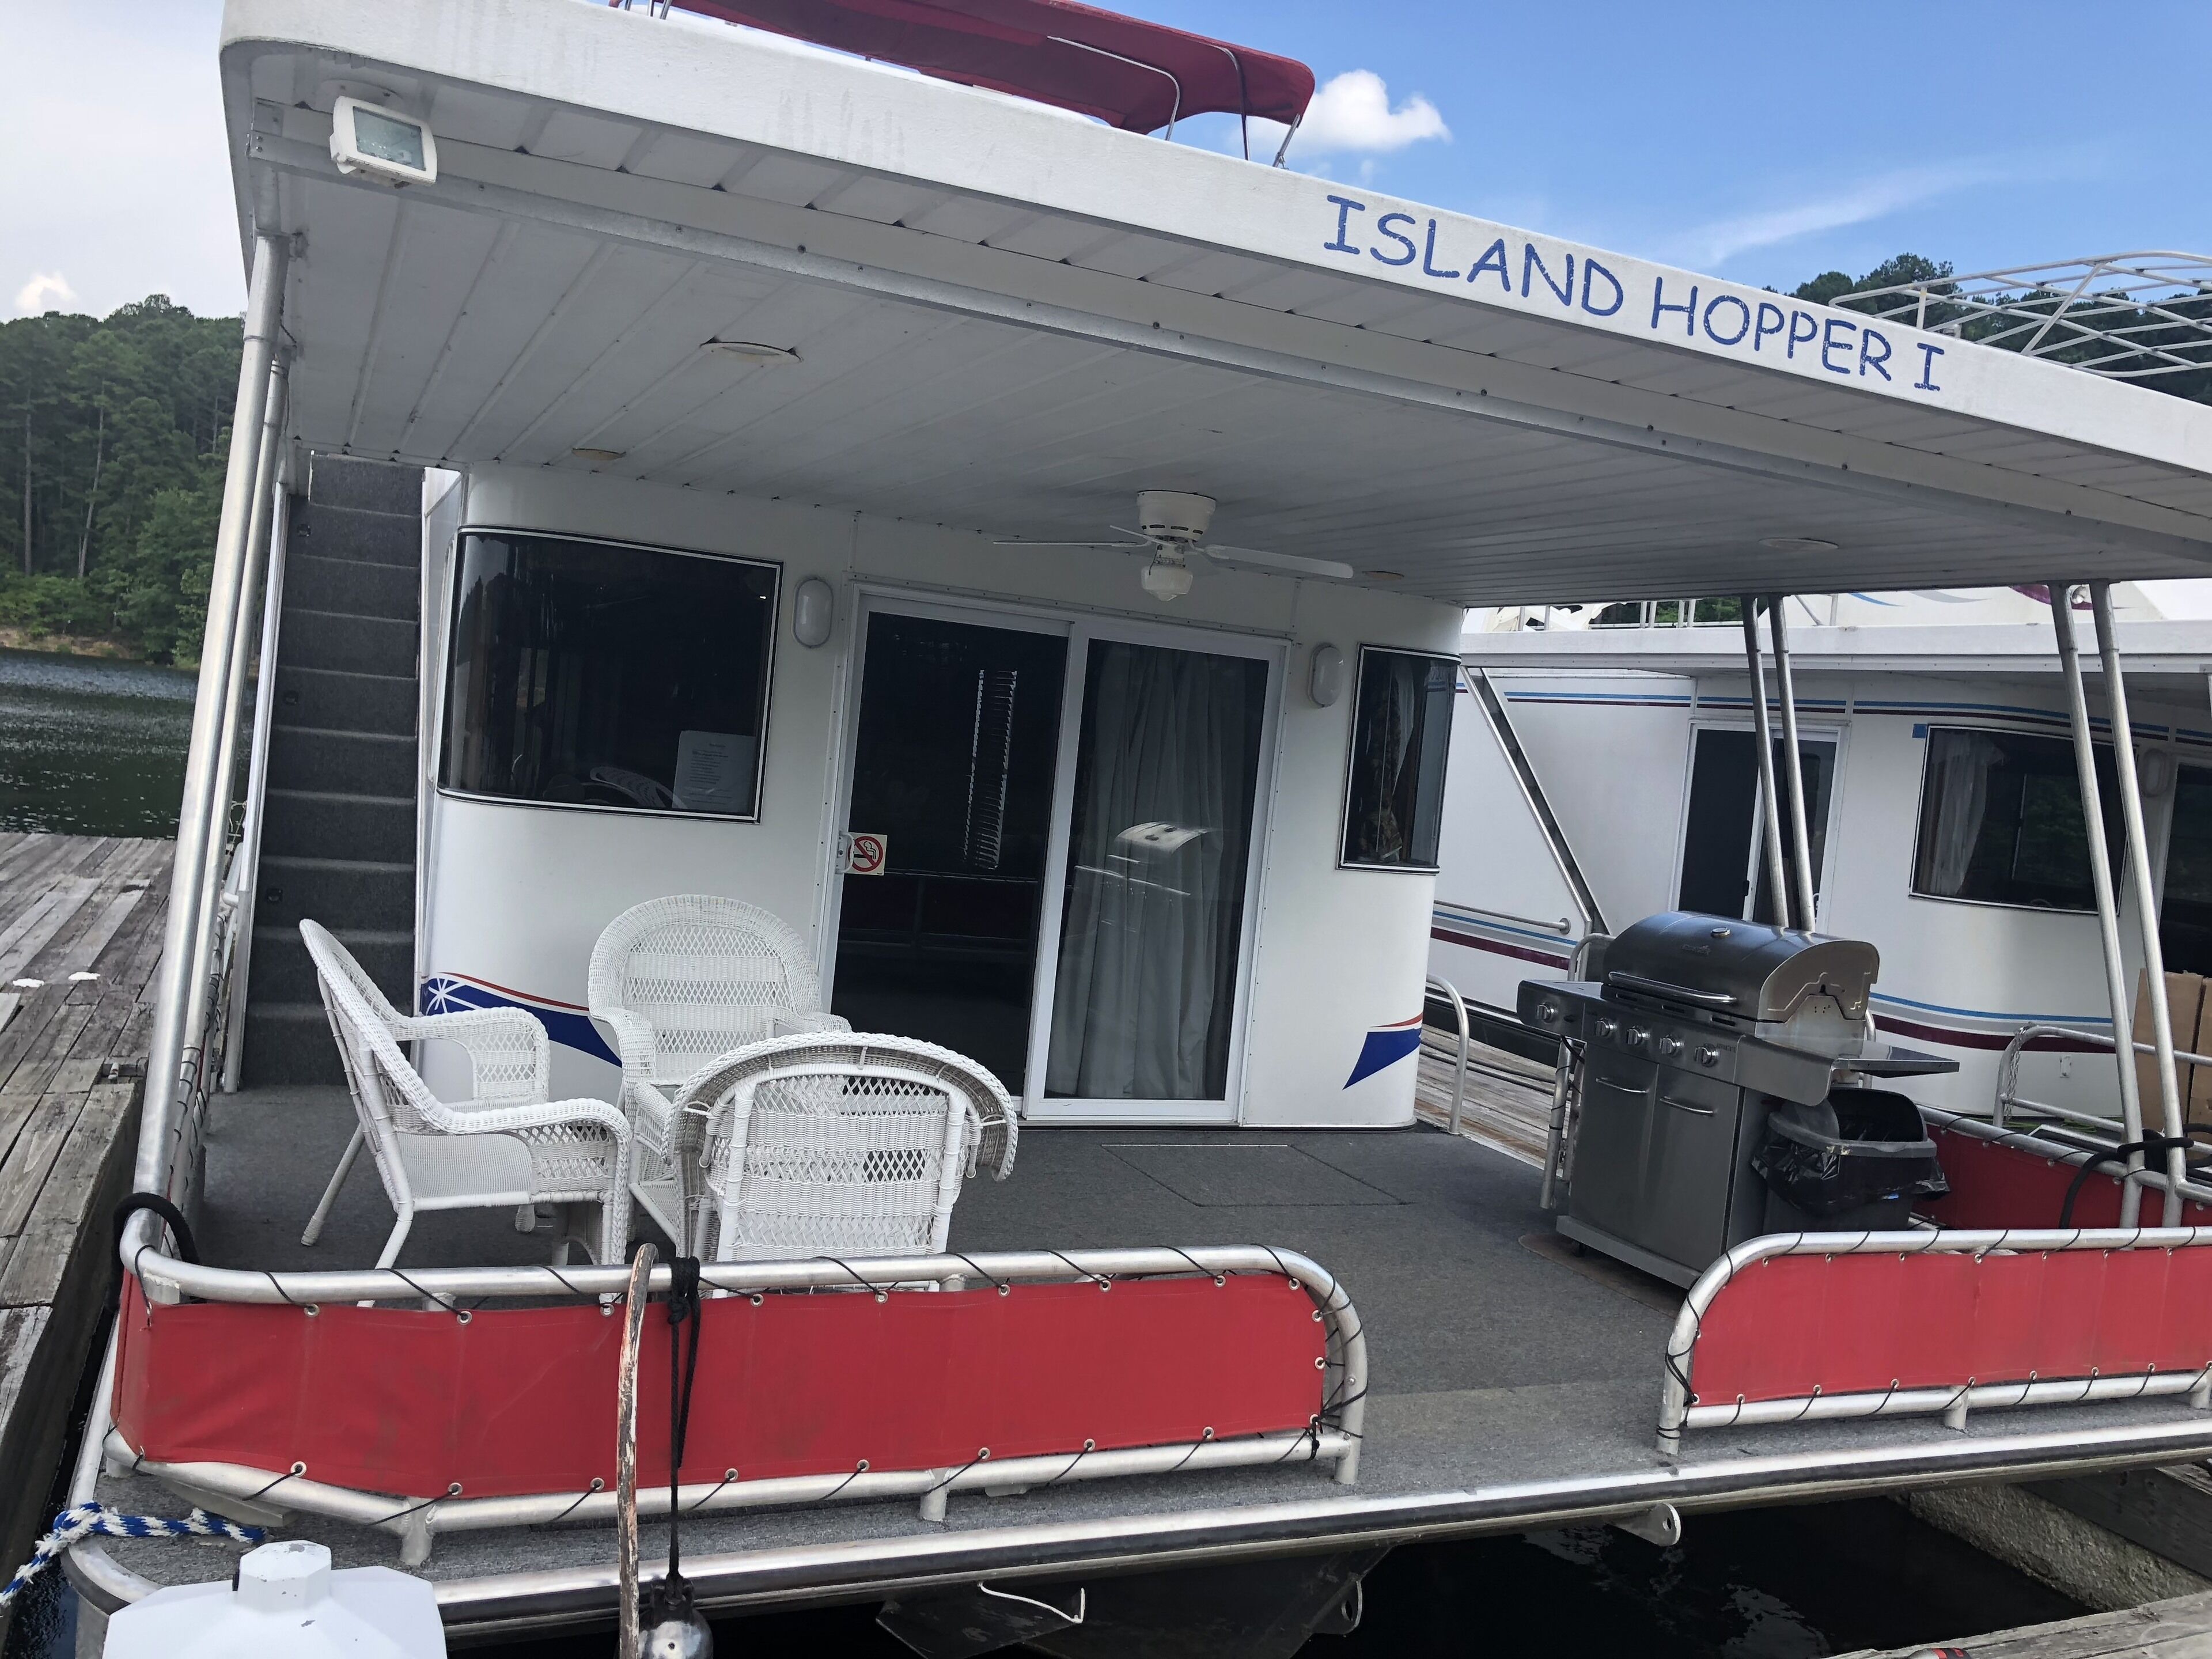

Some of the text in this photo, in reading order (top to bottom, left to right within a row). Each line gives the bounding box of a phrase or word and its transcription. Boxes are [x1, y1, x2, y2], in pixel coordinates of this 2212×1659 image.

[1323, 195, 1945, 392] ISLAND HOPPER I
